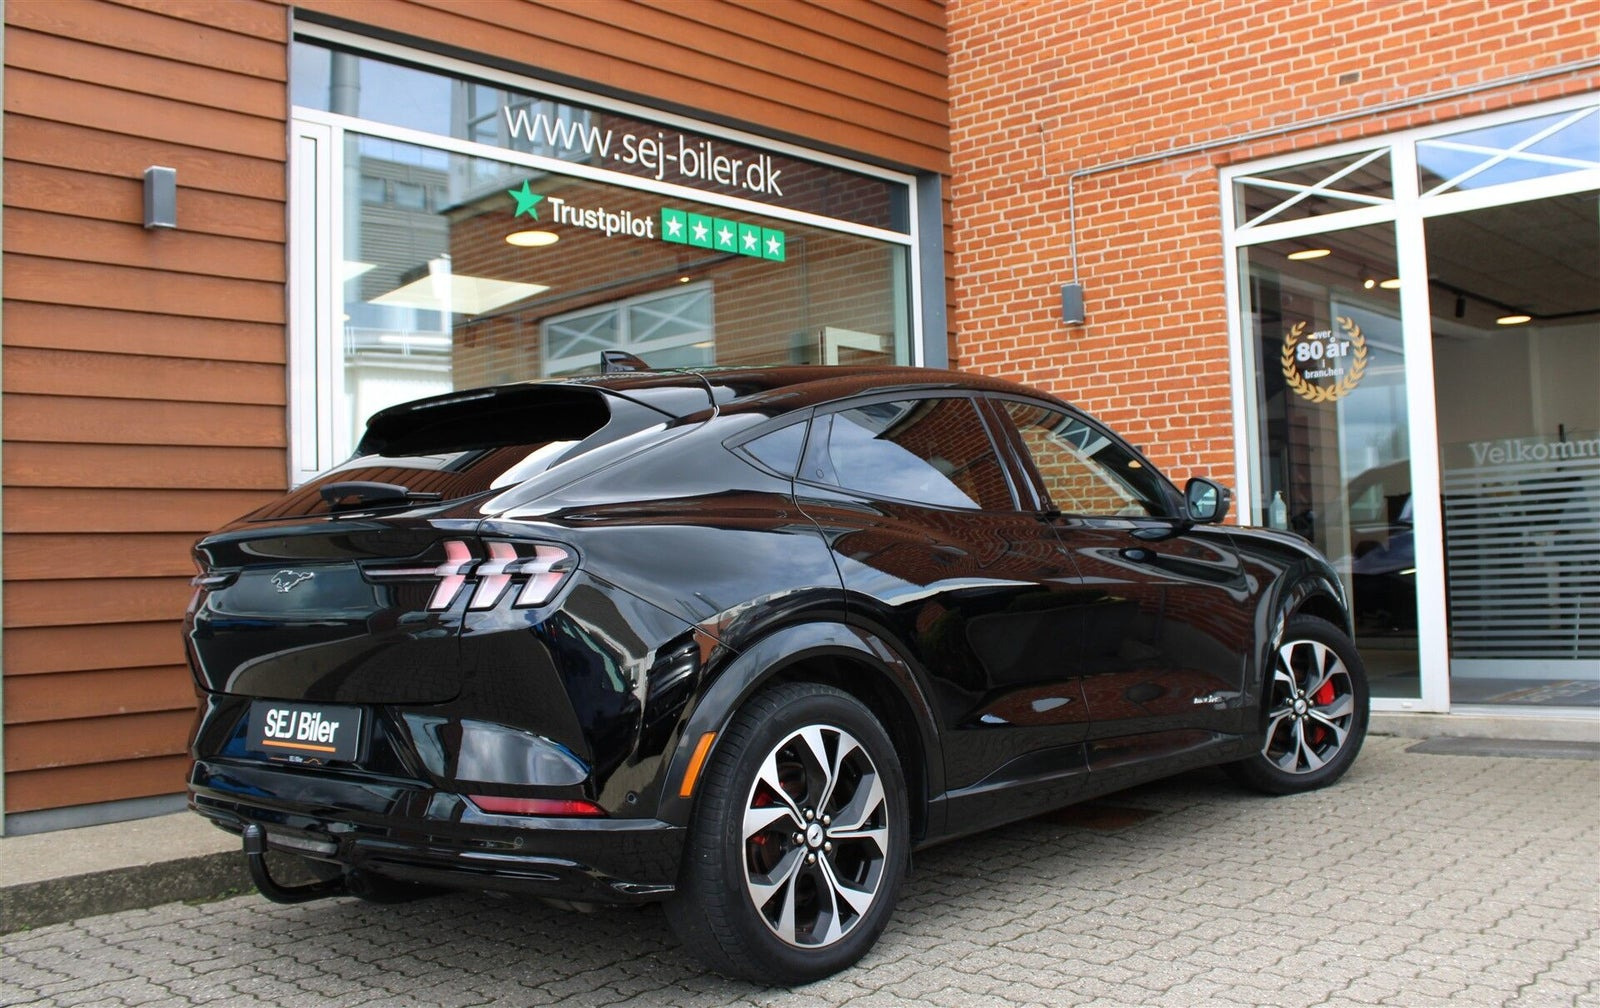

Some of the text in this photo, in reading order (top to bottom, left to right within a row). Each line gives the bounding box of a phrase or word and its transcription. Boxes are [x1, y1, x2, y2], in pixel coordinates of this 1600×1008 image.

[503, 105, 783, 197] www.sej-biler.dk
[547, 196, 655, 239] Trustpilot
[1296, 336, 1350, 362] 80 år
[1304, 367, 1344, 379] branchen
[264, 708, 339, 743] SEJ Biler
